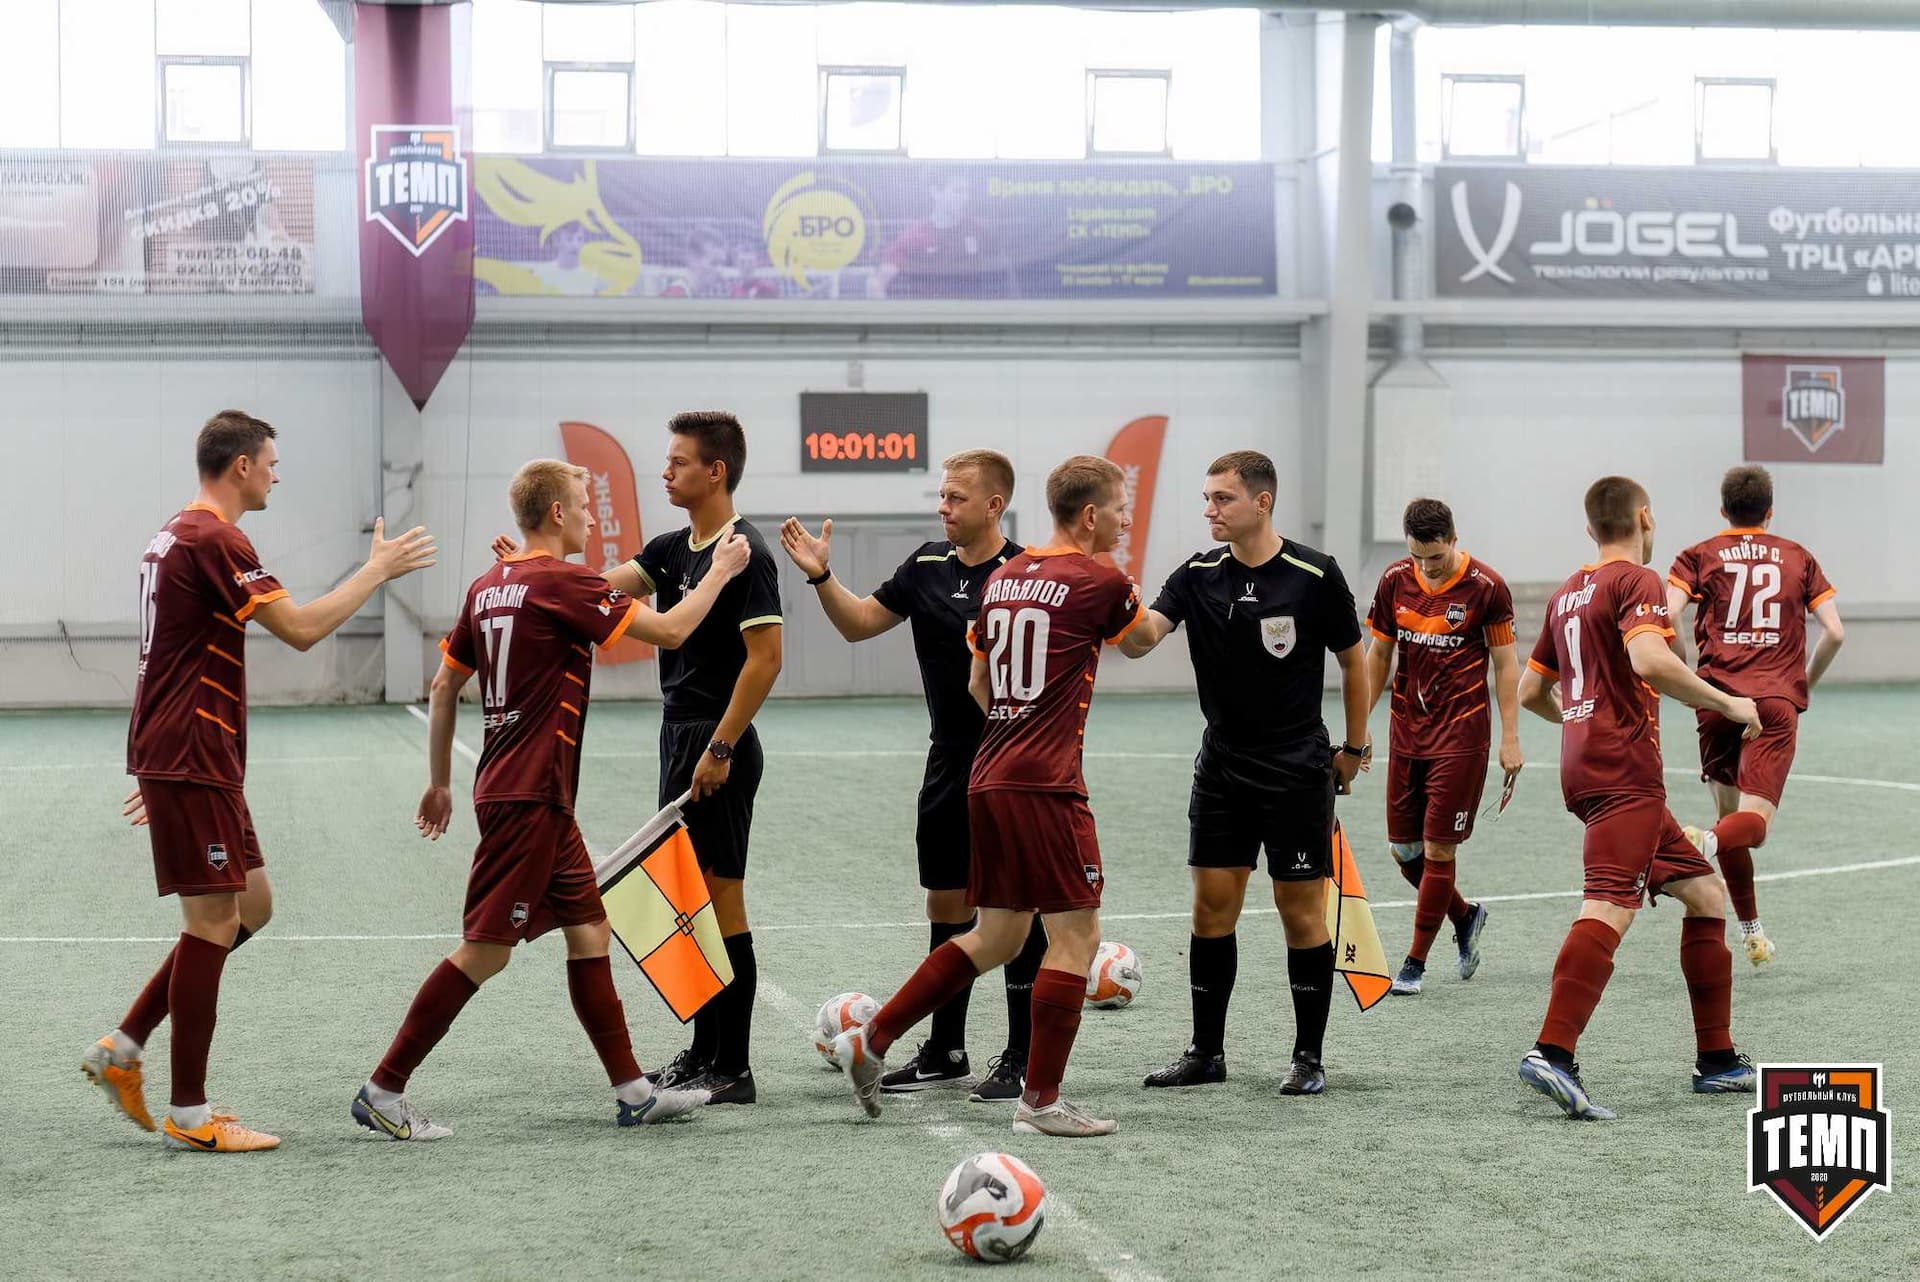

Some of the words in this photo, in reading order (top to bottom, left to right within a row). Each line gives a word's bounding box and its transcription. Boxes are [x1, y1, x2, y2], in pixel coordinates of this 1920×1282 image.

[224, 178, 283, 213] 20%
[376, 160, 457, 207] ТЕМП
[792, 214, 856, 238] .БРО
[1530, 197, 1769, 258] JÖGEL
[1781, 243, 1849, 275] ТРЦ
[1788, 389, 1839, 422] ТЕМП
[804, 431, 916, 460] 19:01:01
[1723, 562, 1782, 629] 72
[986, 607, 1051, 701] 20
[1722, 631, 1781, 645] SEUS
[479, 614, 514, 708] 17
[1454, 811, 1469, 831] 21
[1344, 942, 1357, 964] 2K
